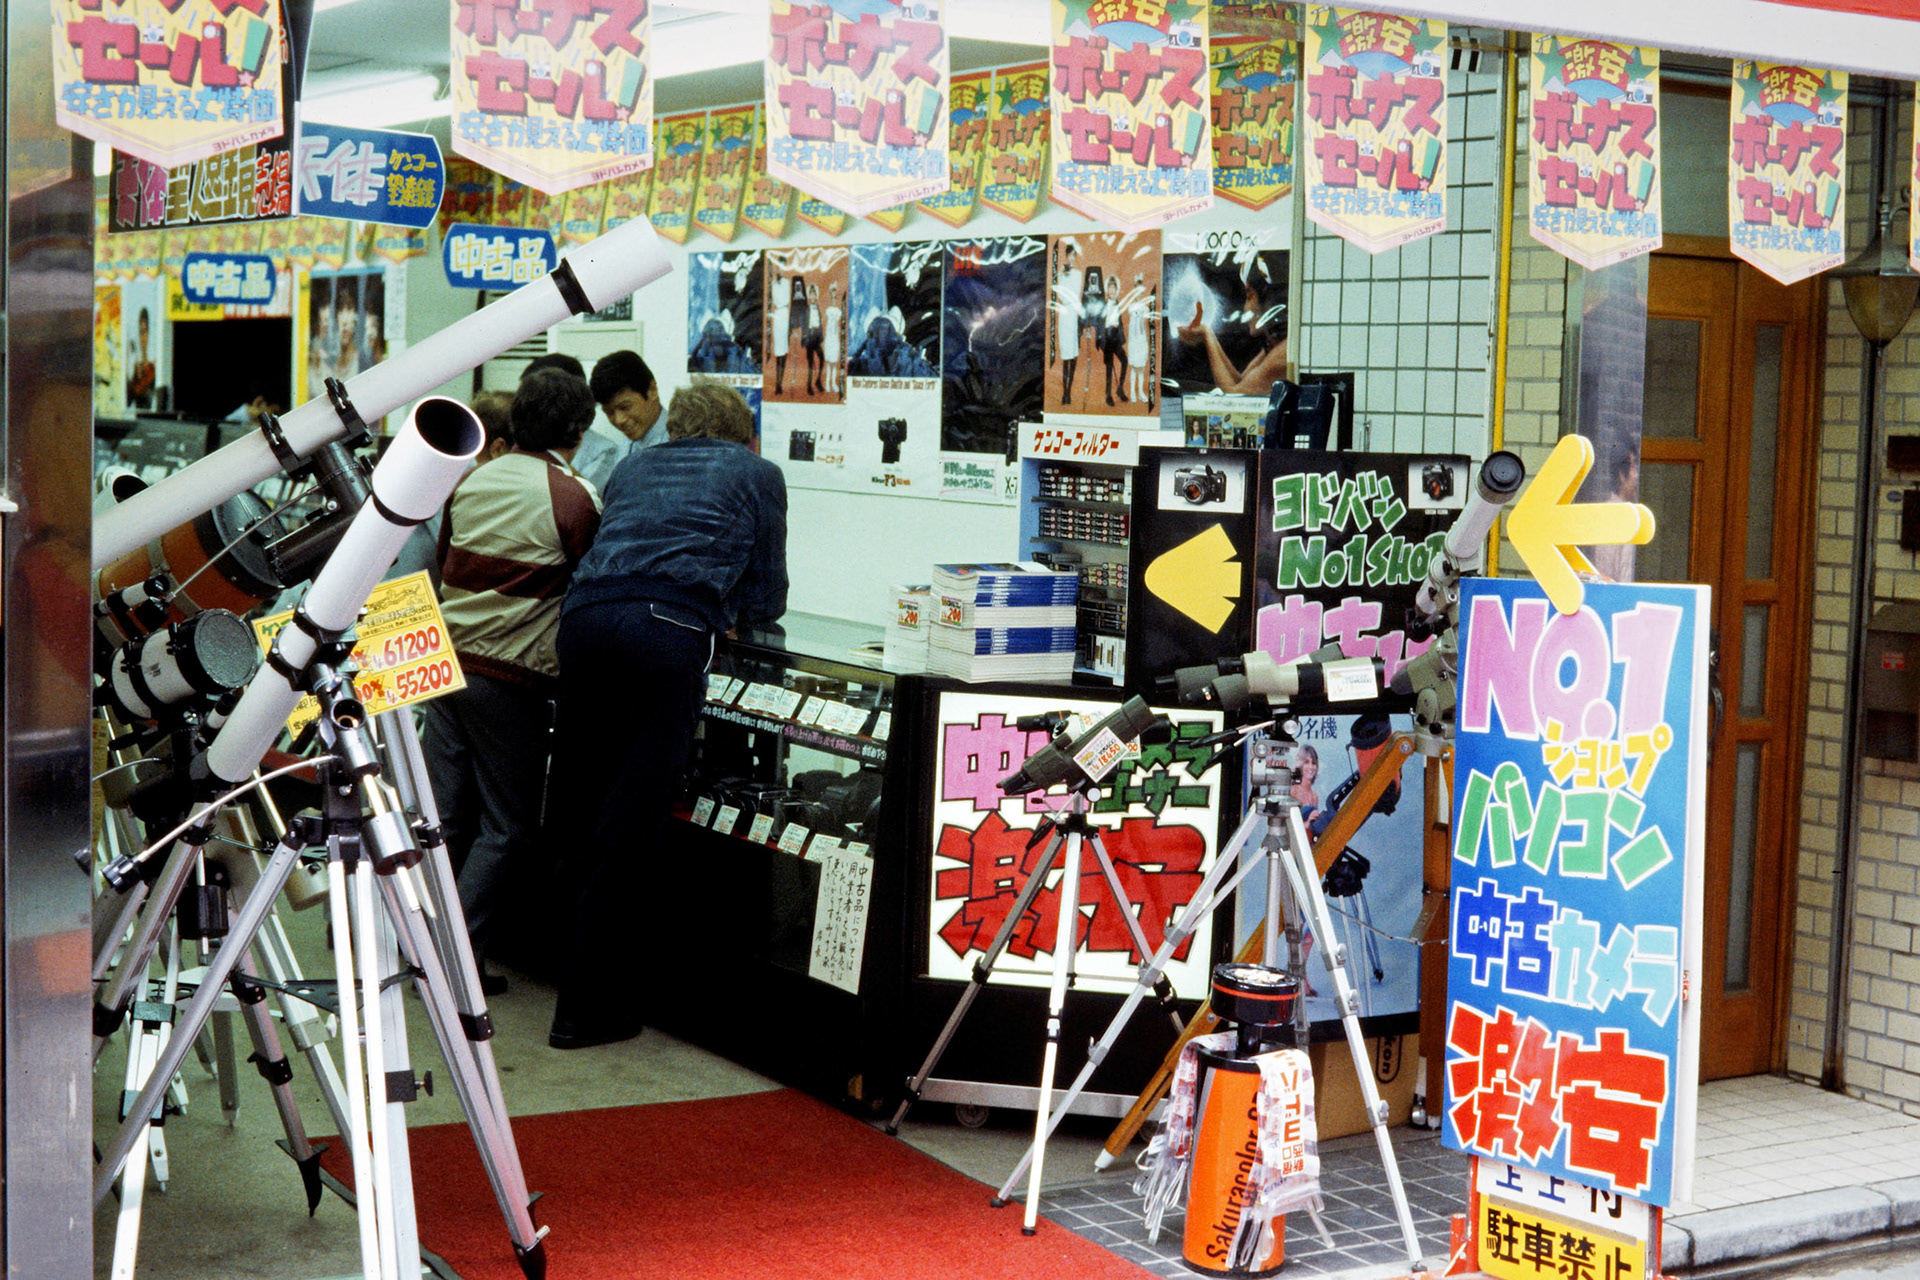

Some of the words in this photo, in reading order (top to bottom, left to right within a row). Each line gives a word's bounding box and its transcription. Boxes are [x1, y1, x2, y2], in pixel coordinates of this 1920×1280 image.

[770, 4, 944, 86] ボーナス
[1343, 14, 1412, 57] 激安
[1565, 44, 1627, 85] 激安
[1053, 35, 1206, 110] ボーナス
[1307, 65, 1444, 136] ボーナス
[1762, 69, 1819, 108] 激安
[389, 148, 437, 171] ケンコー
[1532, 91, 1656, 160] ボーナス
[1731, 114, 1843, 179] ボーナス
[186, 260, 272, 300] 中古品
[450, 233, 547, 283] 中古品
[1034, 430, 1119, 457] ケンコーフィルター
[1273, 470, 1407, 532] ヨドバシ
[1542, 717, 1674, 798] ショップ
[1454, 761, 1673, 891] パソコン
[935, 809, 1207, 965] 激安
[1453, 878, 1678, 1027] 中古カメラ
[1446, 1000, 1670, 1197] 激安
[1486, 1208, 1631, 1280] 駐車禁止
